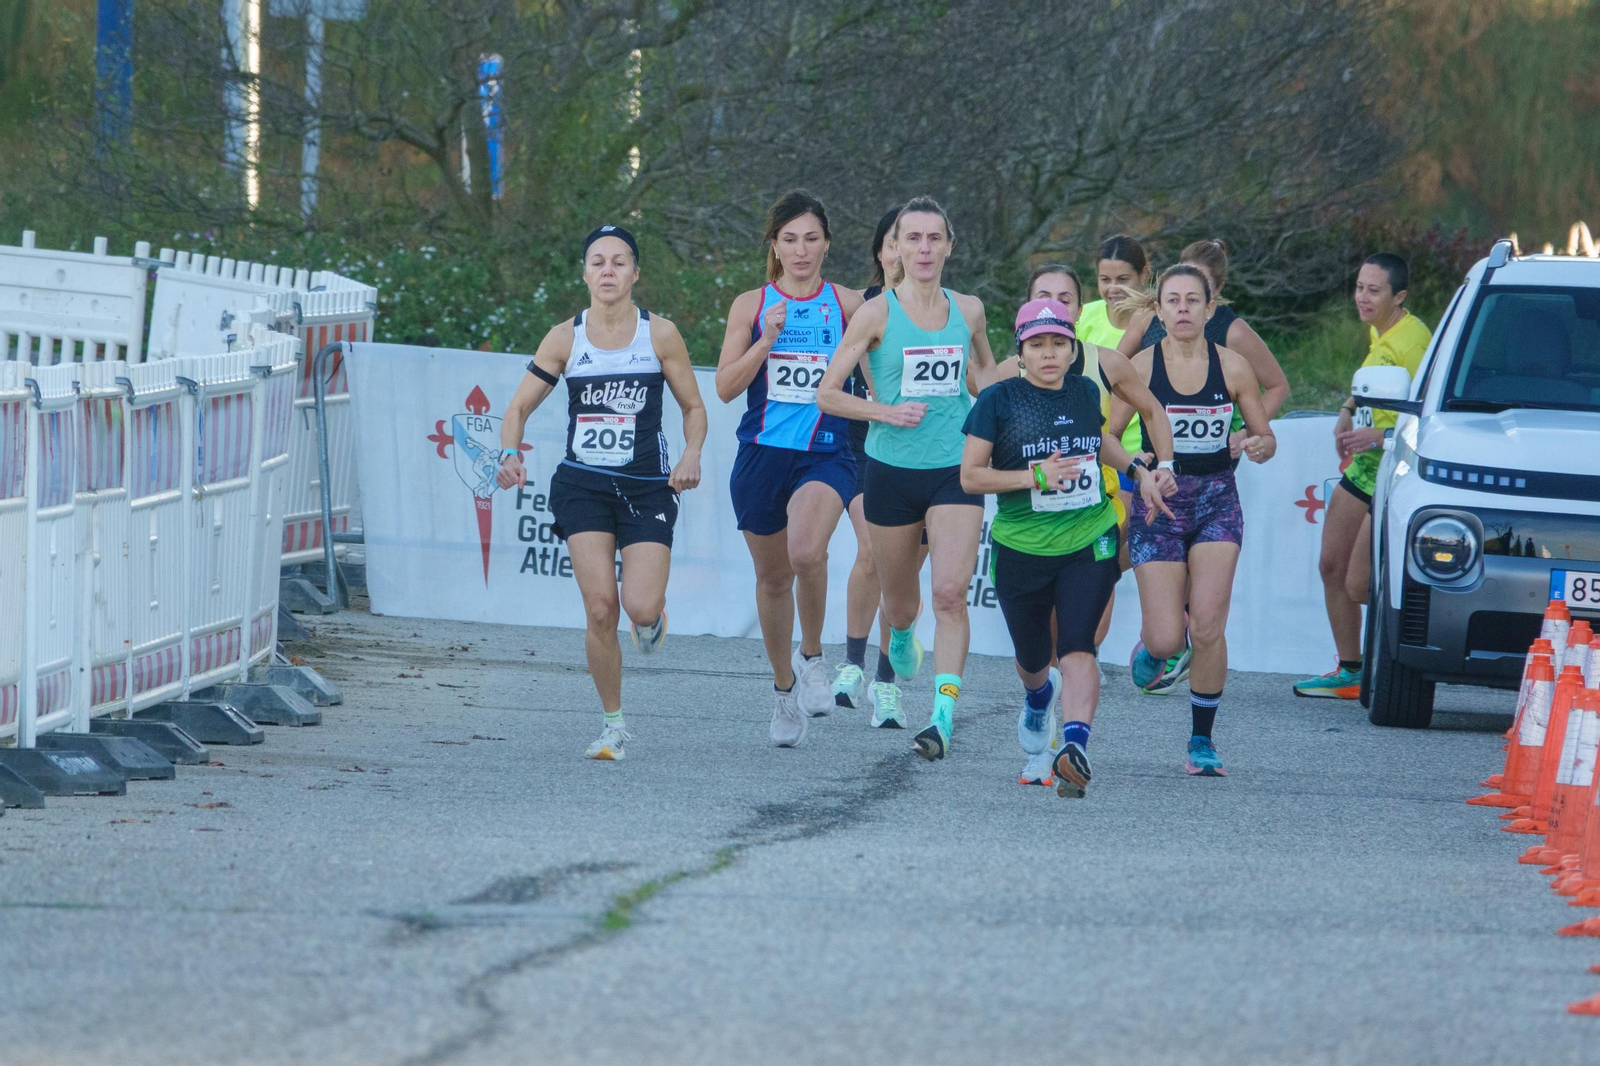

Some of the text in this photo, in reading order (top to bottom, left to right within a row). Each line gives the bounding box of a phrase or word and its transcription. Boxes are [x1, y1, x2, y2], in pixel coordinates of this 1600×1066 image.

[776, 365, 826, 389] 202
[913, 359, 961, 382] 201
[580, 380, 649, 406] delikia
[617, 400, 636, 410] fresh
[466, 416, 493, 433] FGA
[1173, 419, 1225, 439] 203
[581, 428, 635, 451] 205
[1022, 436, 1060, 458] máis
[476, 501, 491, 510] 1921
[1554, 590, 1561, 599] E
